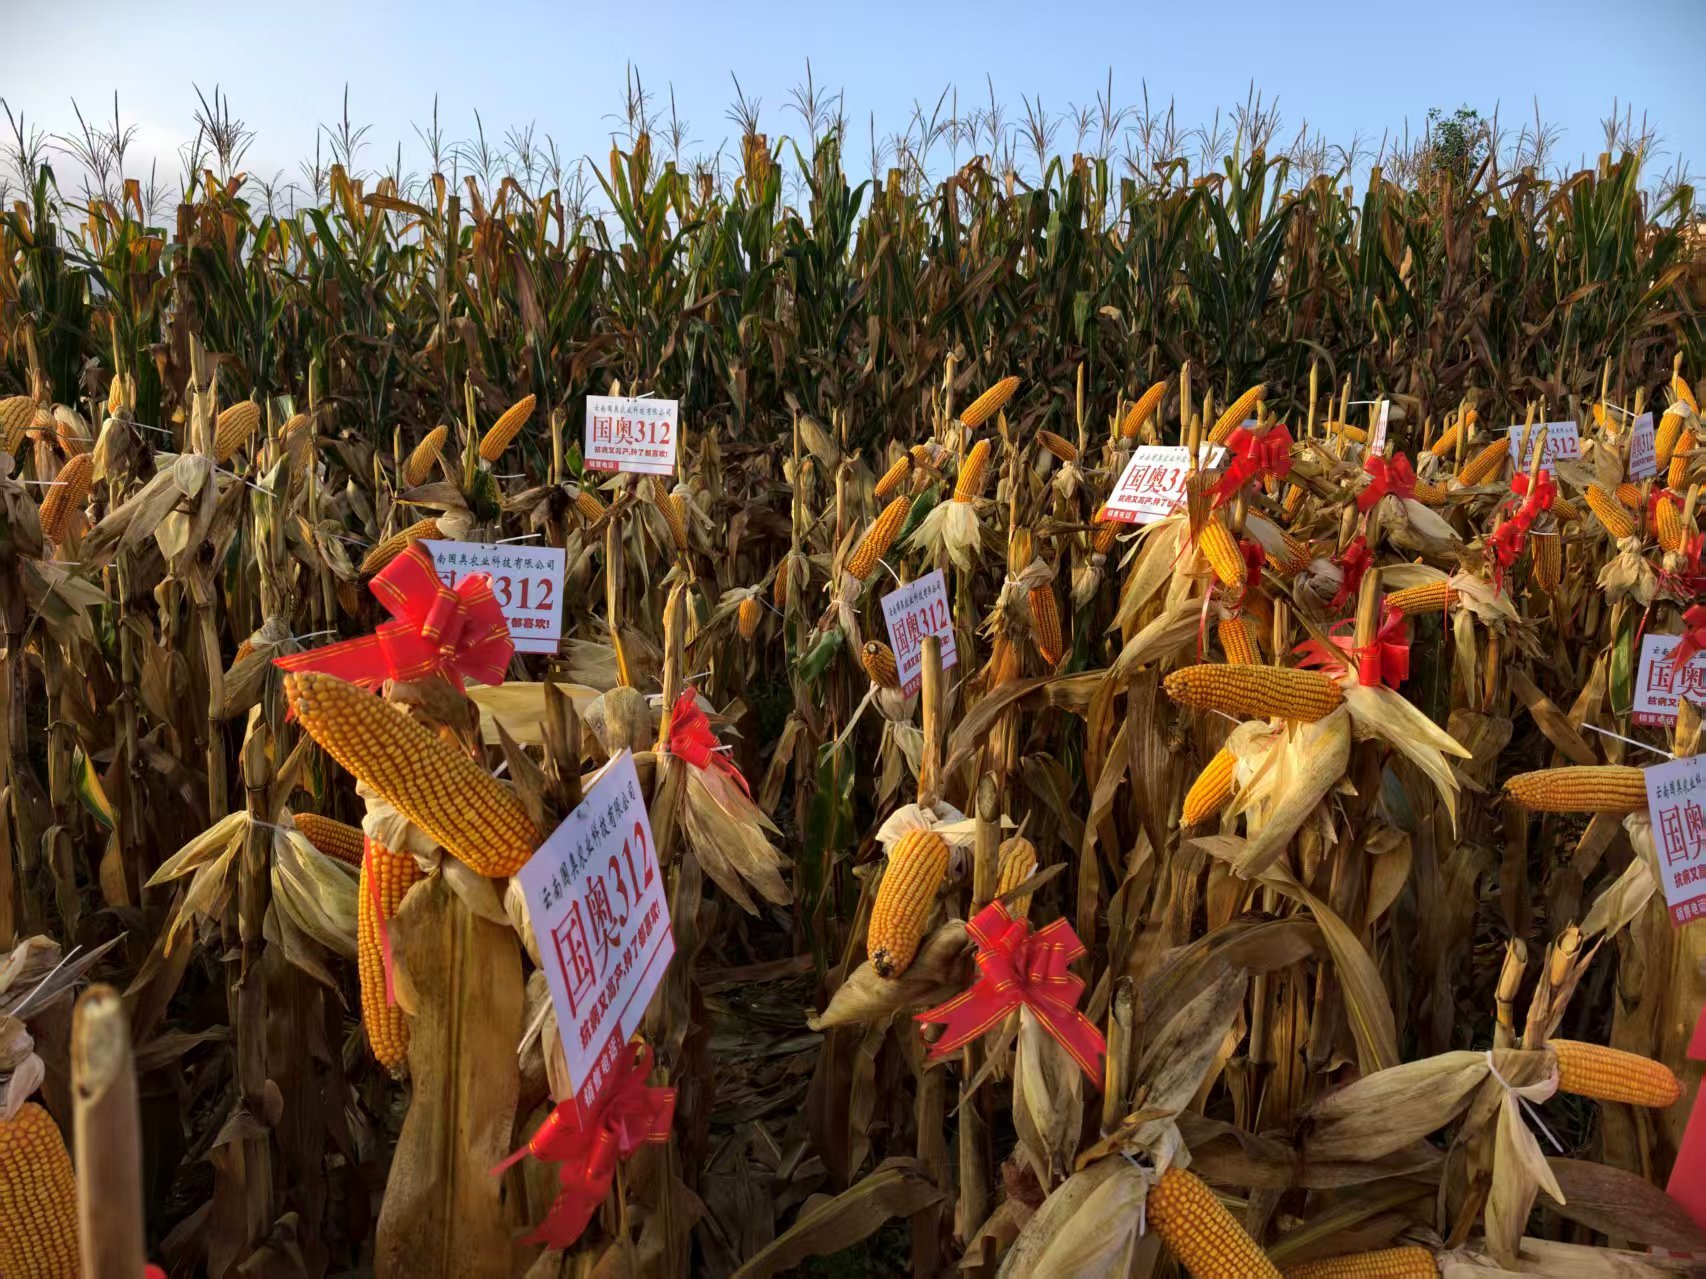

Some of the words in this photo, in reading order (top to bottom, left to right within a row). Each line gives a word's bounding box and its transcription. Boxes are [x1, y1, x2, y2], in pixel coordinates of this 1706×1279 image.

[593, 416, 671, 445] 国奥312
[892, 598, 949, 660] 国奥312
[551, 821, 654, 1020] 国奥312
